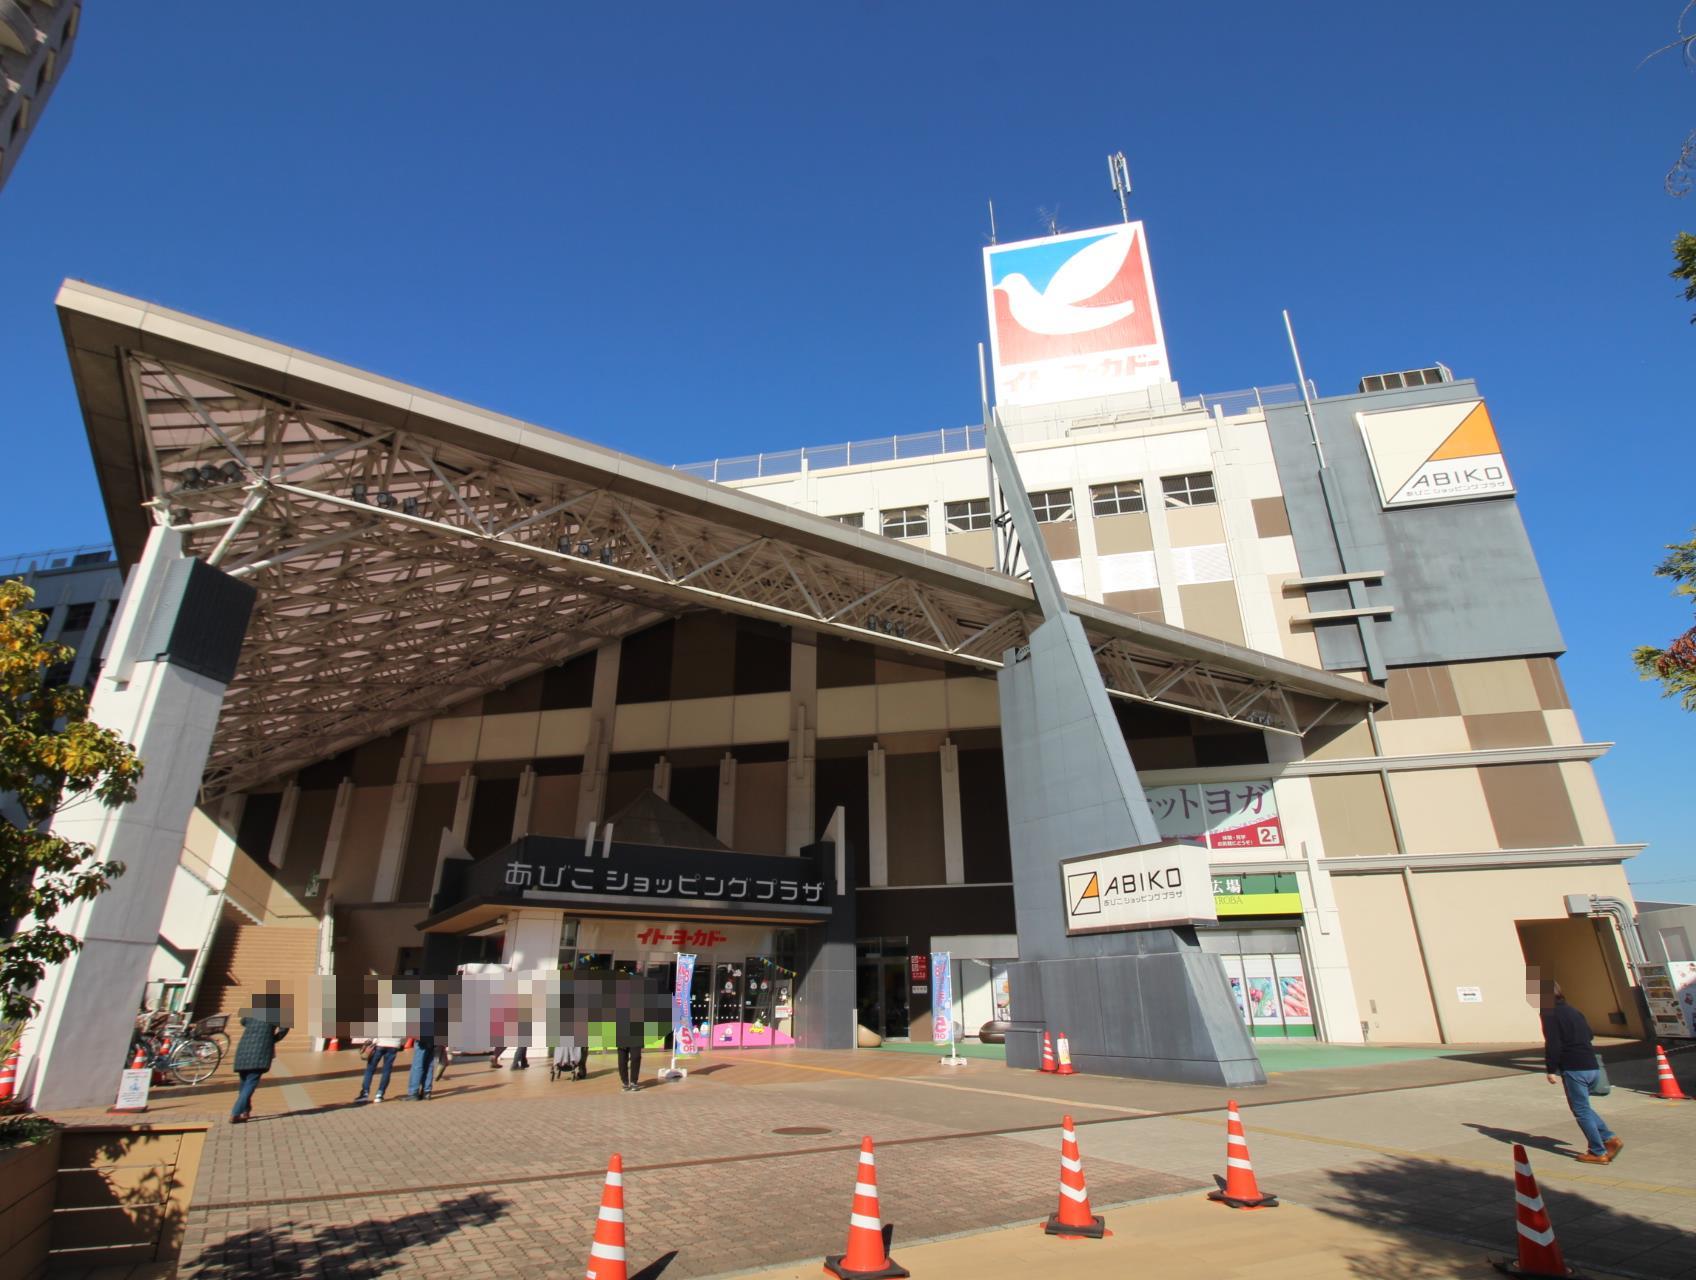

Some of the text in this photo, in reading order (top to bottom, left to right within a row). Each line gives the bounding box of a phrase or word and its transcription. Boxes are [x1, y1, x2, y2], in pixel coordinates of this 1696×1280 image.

[1412, 466, 1503, 489] ABIKO
[1260, 828, 1277, 843] 2F
[1104, 867, 1182, 897] ABIKO
[637, 927, 728, 947] イトーヨーカドー
